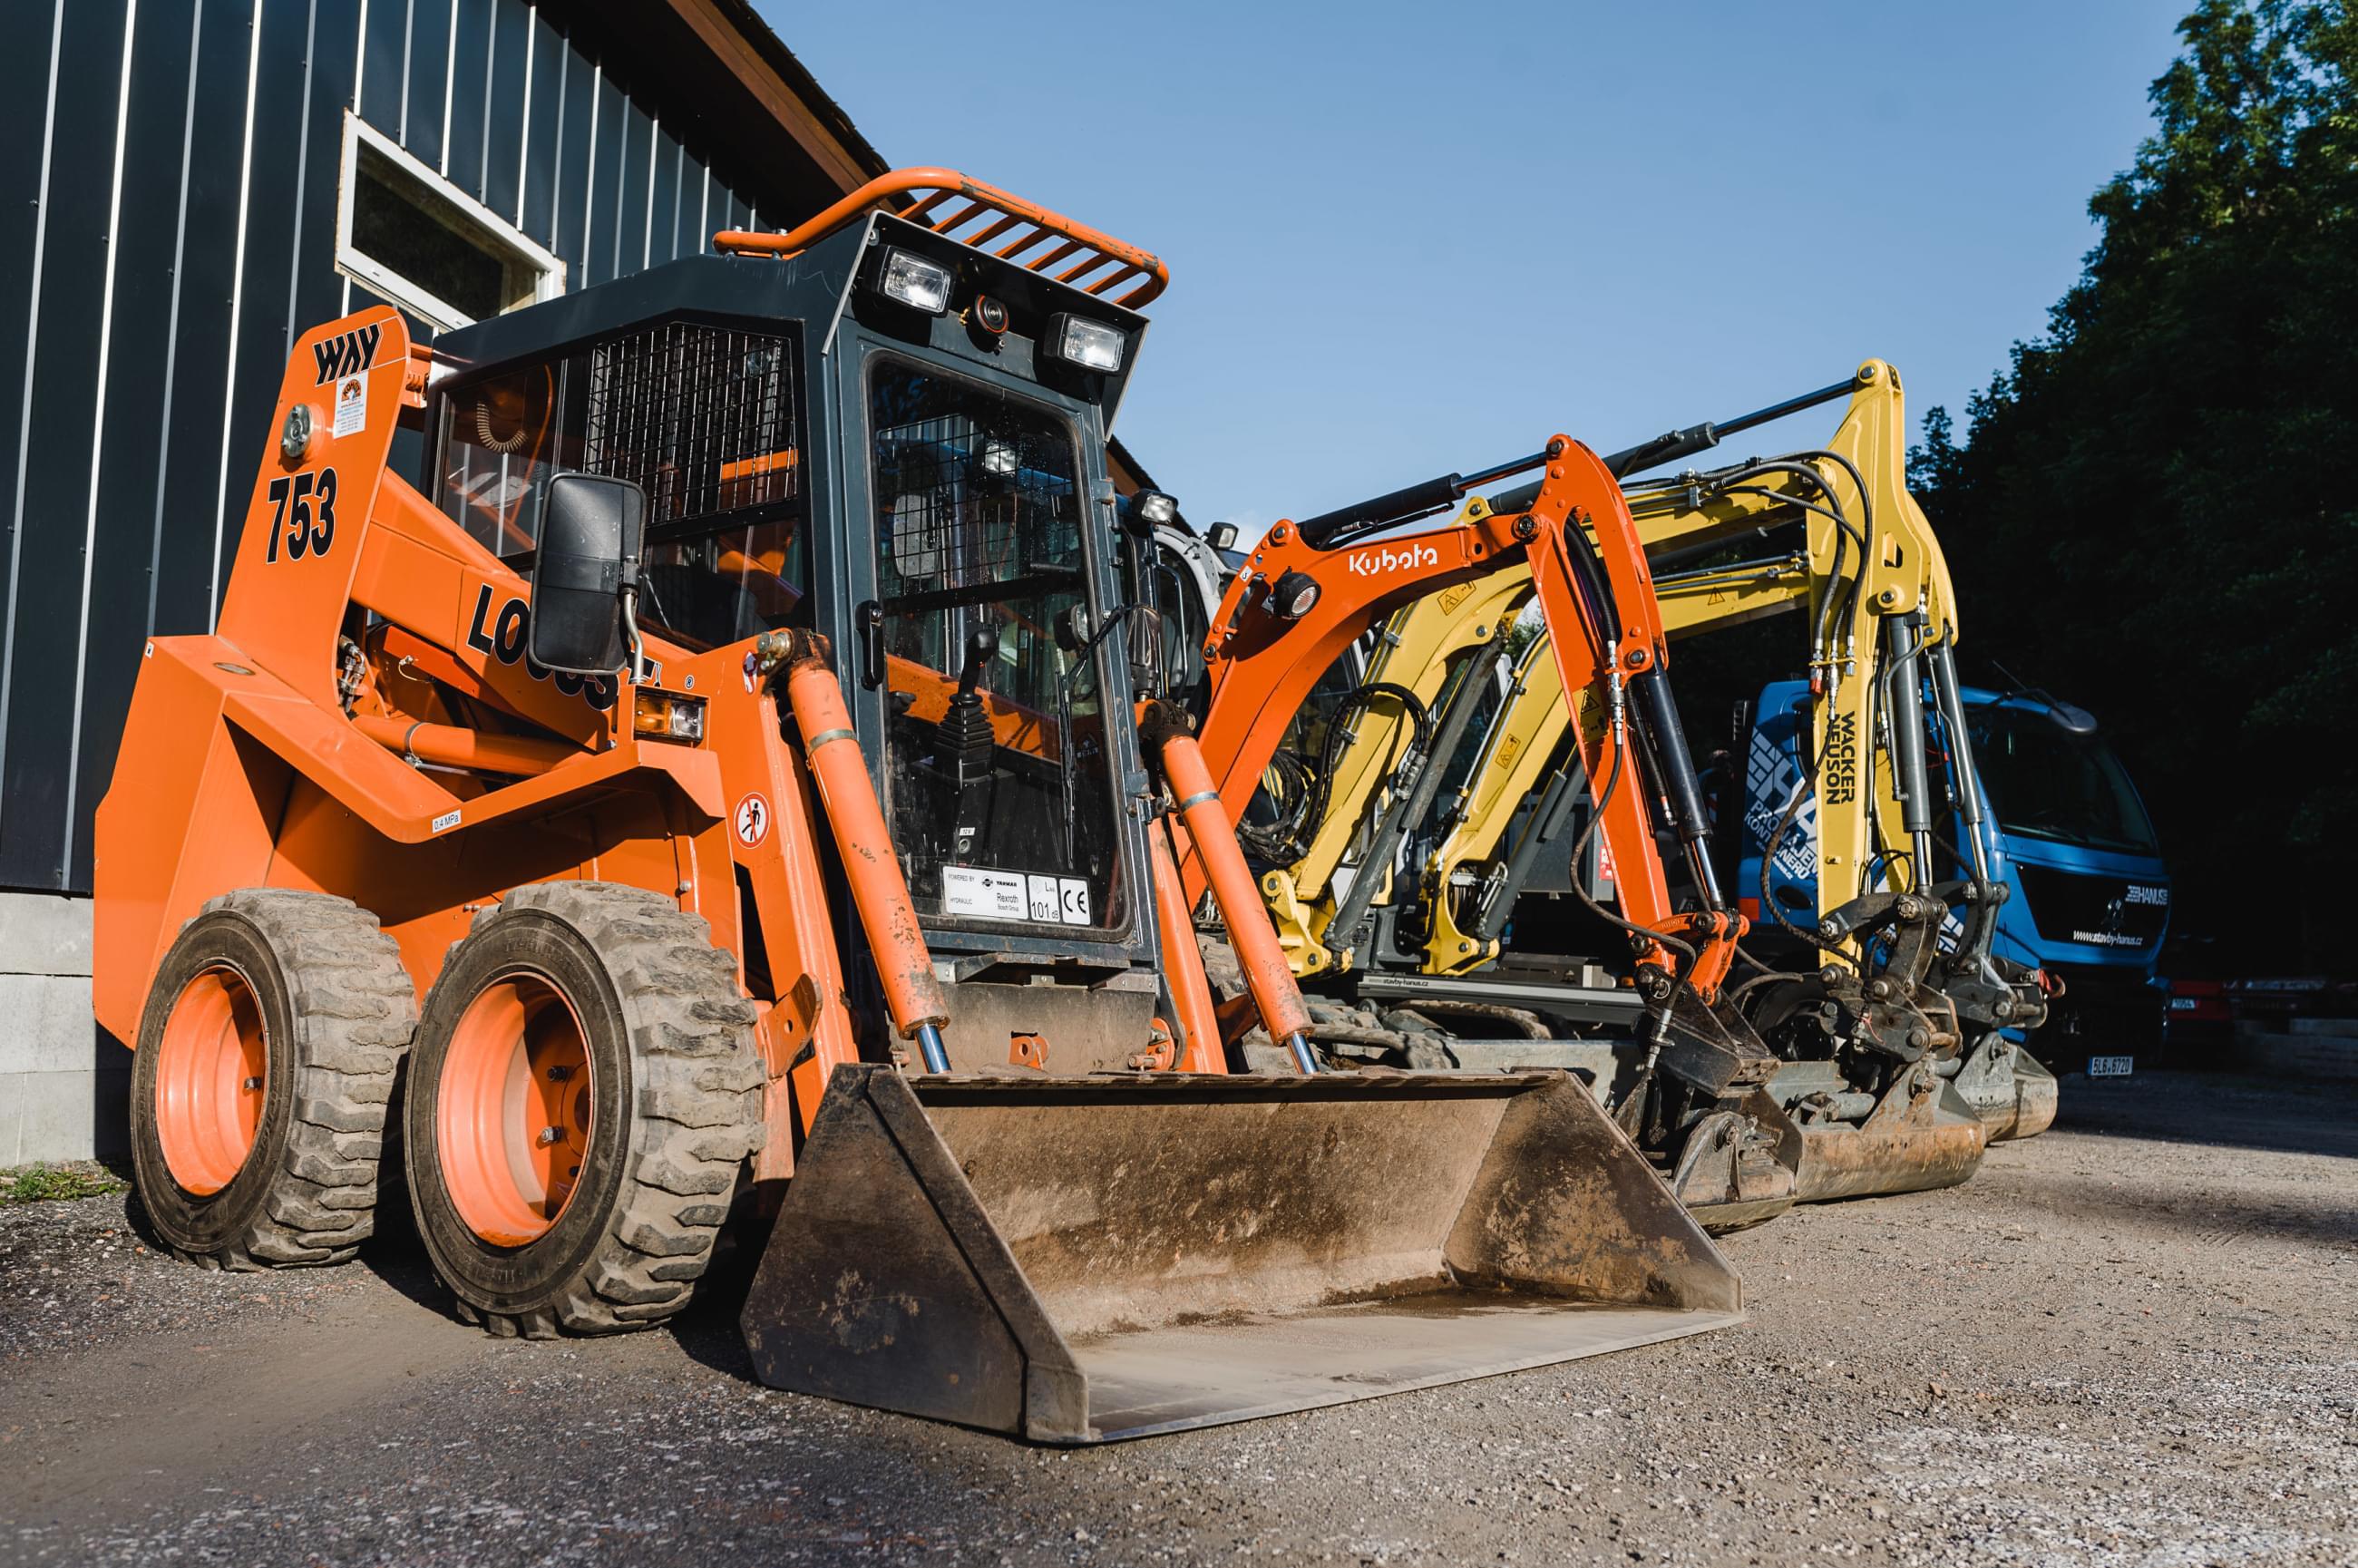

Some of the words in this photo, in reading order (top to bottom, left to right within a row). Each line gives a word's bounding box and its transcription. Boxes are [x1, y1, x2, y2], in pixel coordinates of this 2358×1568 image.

[313, 323, 382, 387] WAY
[267, 466, 338, 565] 753
[1349, 543, 1437, 576] Kubota
[467, 583, 656, 712] LOS
[1841, 710, 1856, 804] WACKER
[1744, 812, 1810, 880] KONTJNERŮ
[997, 892, 1018, 903] Rexroth
[1031, 901, 1049, 919] 101
[2073, 930, 2143, 947] www.stavby-hanus.cz
